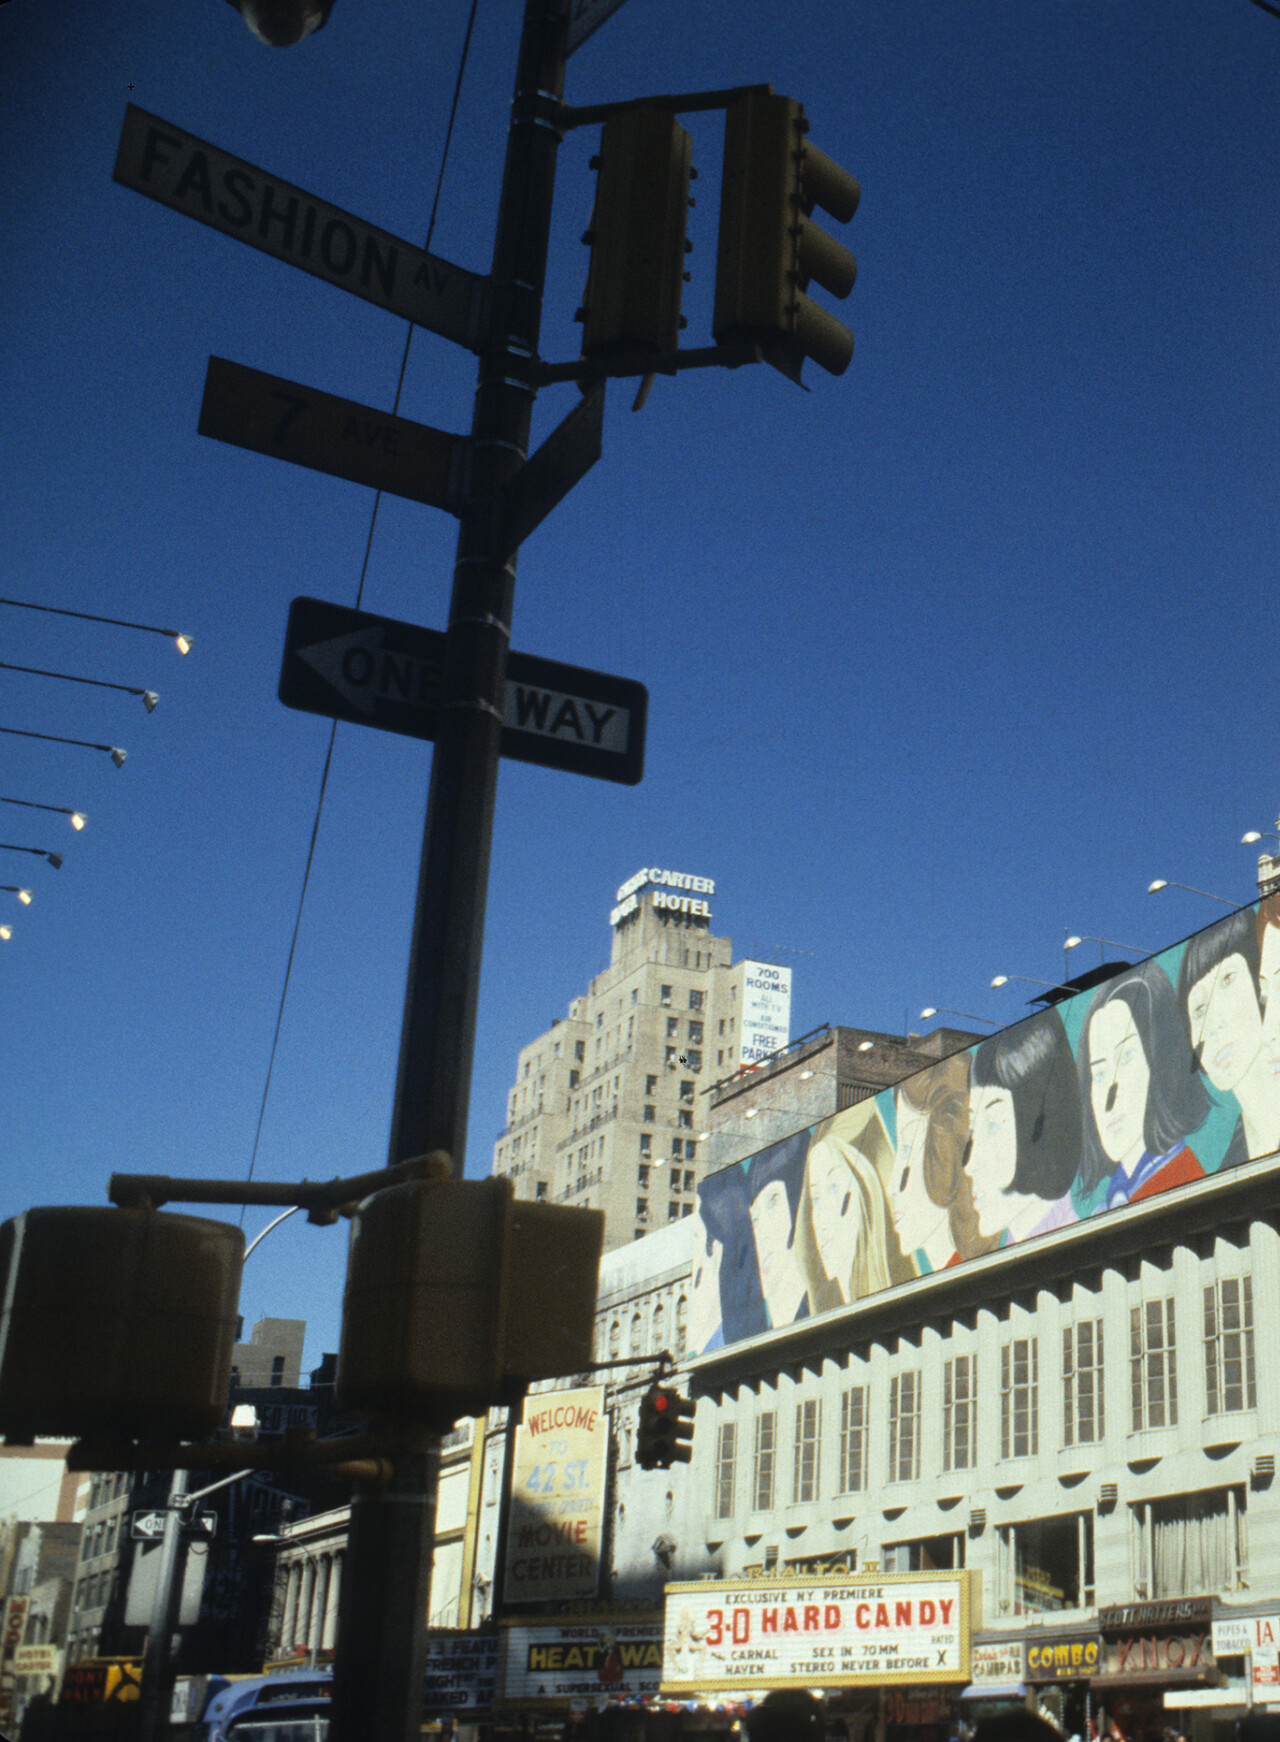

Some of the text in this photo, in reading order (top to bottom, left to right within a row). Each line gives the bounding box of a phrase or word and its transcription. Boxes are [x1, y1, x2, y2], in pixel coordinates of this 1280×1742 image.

[142, 126, 450, 298] FASHION AV
[270, 391, 308, 446] 7
[342, 646, 616, 743] ONE WAY
[648, 868, 715, 894] CARTER
[652, 891, 713, 917] HOTEL
[757, 968, 780, 980] 700
[746, 977, 788, 994] ROOMS
[753, 1033, 778, 1049] FREE
[528, 1405, 598, 1437] WELCOME
[550, 1440, 568, 1455] TO
[526, 1460, 591, 1493] 42 ST.
[519, 1521, 588, 1548] MOVIE
[512, 1554, 592, 1582] CENTER
[748, 1563, 849, 1579] RIALTO
[725, 1588, 884, 1605] EXCLUSIVE NY PREMIERE
[762, 1604, 842, 1633] HARD
[856, 1598, 954, 1630] CANDY
[561, 1625, 662, 1639] WORLD PREMIER
[1217, 1624, 1240, 1636] PIPES
[931, 1634, 955, 1645] RATED
[1217, 1638, 1251, 1651] TOBACCO
[530, 1644, 664, 1671] HEAT WA
[731, 1649, 779, 1661] CARNAL
[812, 1647, 834, 1658] SEX
[841, 1646, 853, 1657] IN
[936, 1649, 948, 1667] X
[1028, 1641, 1098, 1669] COMBO
[1117, 1631, 1208, 1672] KNOX
[725, 1664, 765, 1675] HAVEN
[790, 1657, 930, 1674] STEREO NEVER BEFORE
[538, 1685, 546, 1695] A
[556, 1682, 632, 1694] SUPERSEXUAL
